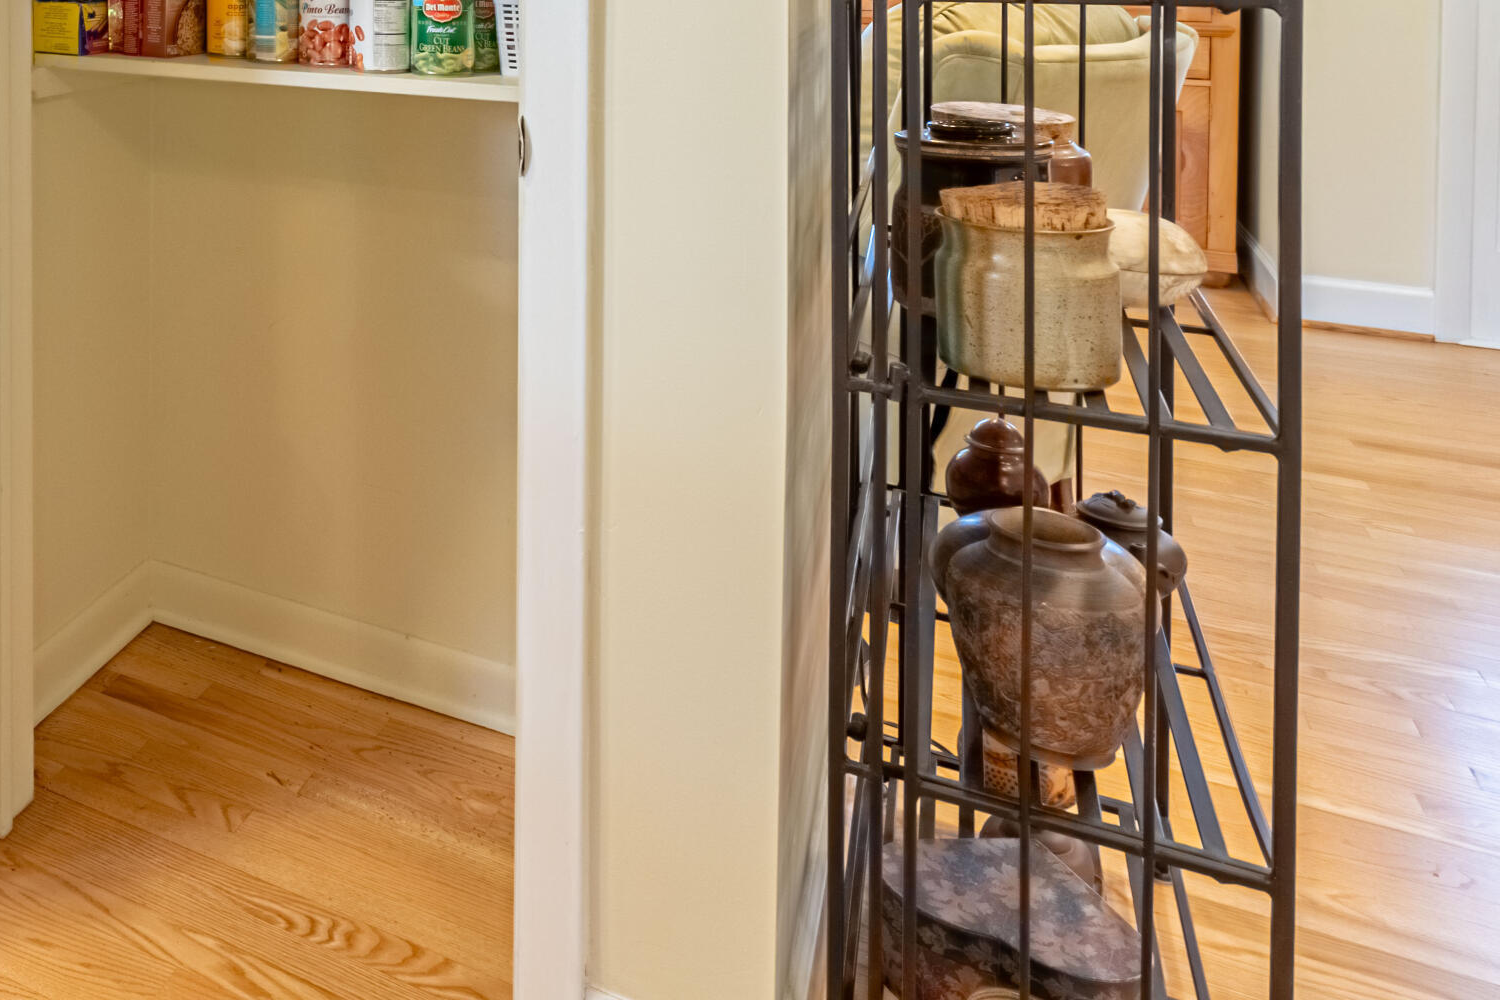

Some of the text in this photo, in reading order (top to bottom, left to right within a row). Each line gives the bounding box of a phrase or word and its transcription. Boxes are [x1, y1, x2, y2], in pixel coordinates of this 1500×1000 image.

[302, 3, 350, 14] Pinto Bean
[427, 25, 443, 33] Fresh
[433, 36, 450, 44] CUT
[419, 43, 465, 53] GREEN BEANS
